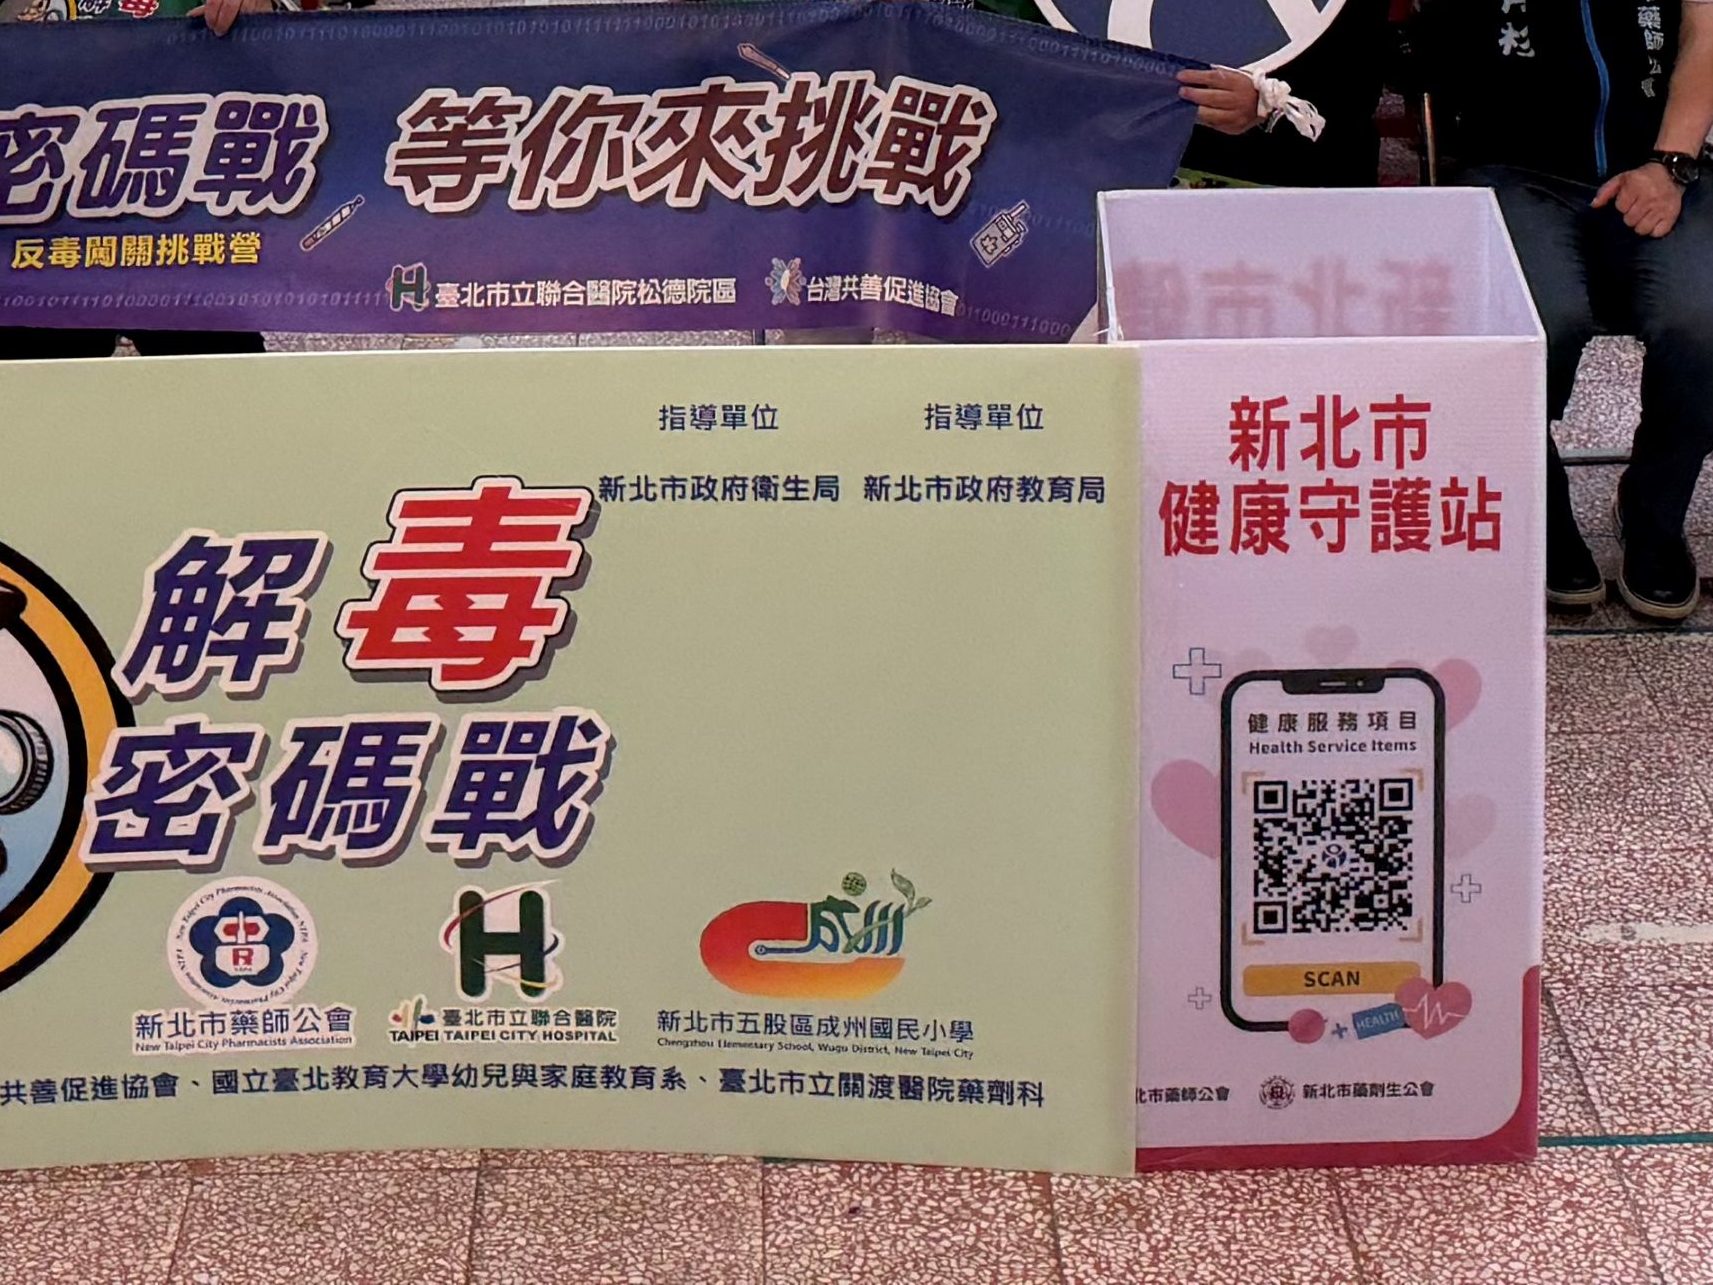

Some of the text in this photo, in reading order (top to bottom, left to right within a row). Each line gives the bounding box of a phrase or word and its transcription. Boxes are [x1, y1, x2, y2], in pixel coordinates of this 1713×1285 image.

[388, 72, 994, 215] 等你來挑戰
[12, 232, 261, 269] 反毒闖關挑戰營
[435, 278, 737, 308] 臺北市立聯合醫院松德院區
[807, 275, 959, 317] 台灣共善促進協會
[659, 404, 779, 430] 指導單位
[924, 404, 1044, 430] 指導單位
[1229, 394, 1432, 471] 新北市
[598, 475, 840, 503] 新北市政府衛生局
[864, 475, 1105, 504] 新北市政府教育局
[1158, 476, 1502, 556] 健康守護站
[1248, 711, 1417, 734] 健康服務項目
[1249, 738, 1417, 755] Health Service Items
[88, 715, 606, 860] 密碼戰
[1303, 970, 1361, 988] SCAN
[136, 1006, 354, 1040] 新北市藥師公會
[442, 1008, 617, 1029] 臺北市立聯合醫院
[657, 1009, 974, 1043] 新北市五股區成州國民小學
[136, 1035, 352, 1052] New Taipei City Pharmacists Association
[389, 1030, 439, 1043] TAIPEI
[444, 1029, 618, 1043] TAIPEI CITY HOSPITAL
